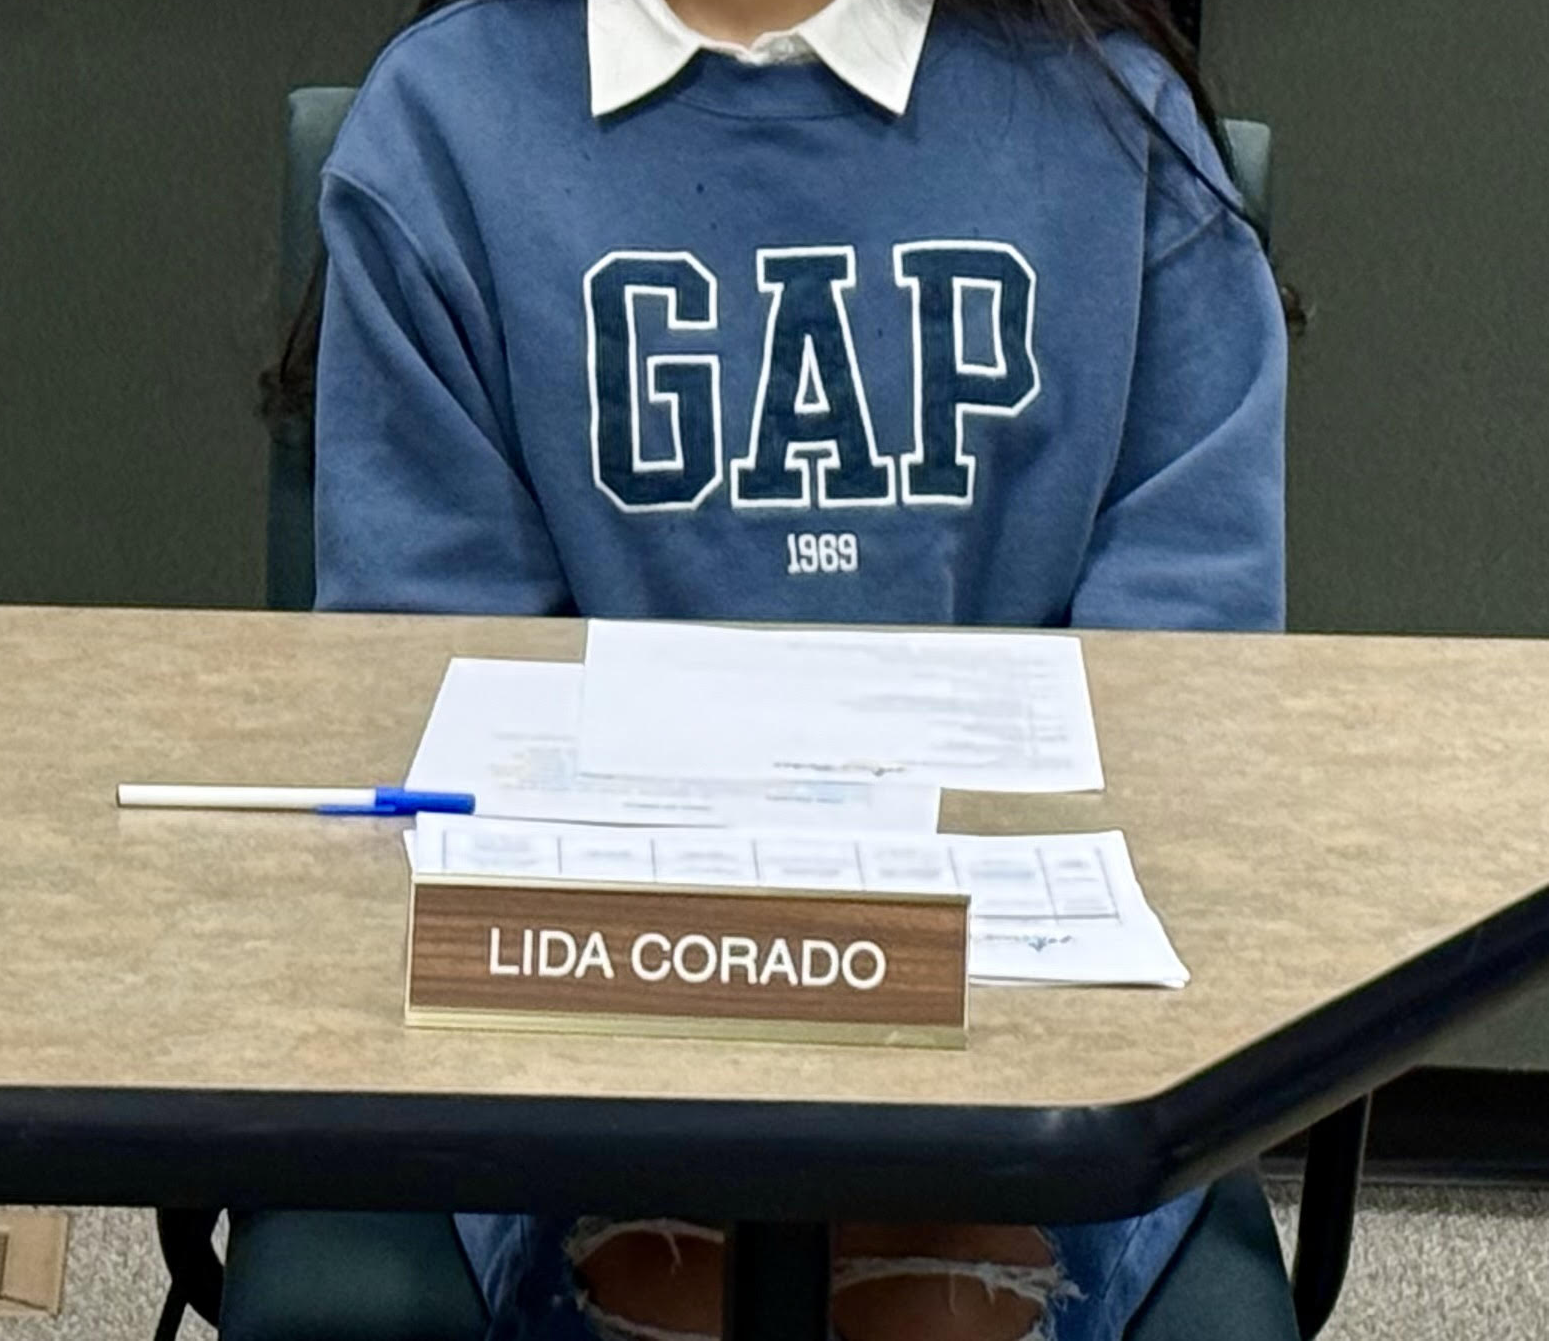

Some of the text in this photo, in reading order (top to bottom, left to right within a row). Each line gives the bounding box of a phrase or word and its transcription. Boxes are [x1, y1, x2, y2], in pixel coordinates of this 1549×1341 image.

[582, 239, 1041, 514] GAP
[787, 533, 859, 574] 1969
[489, 927, 887, 990] LIDA CORADO
